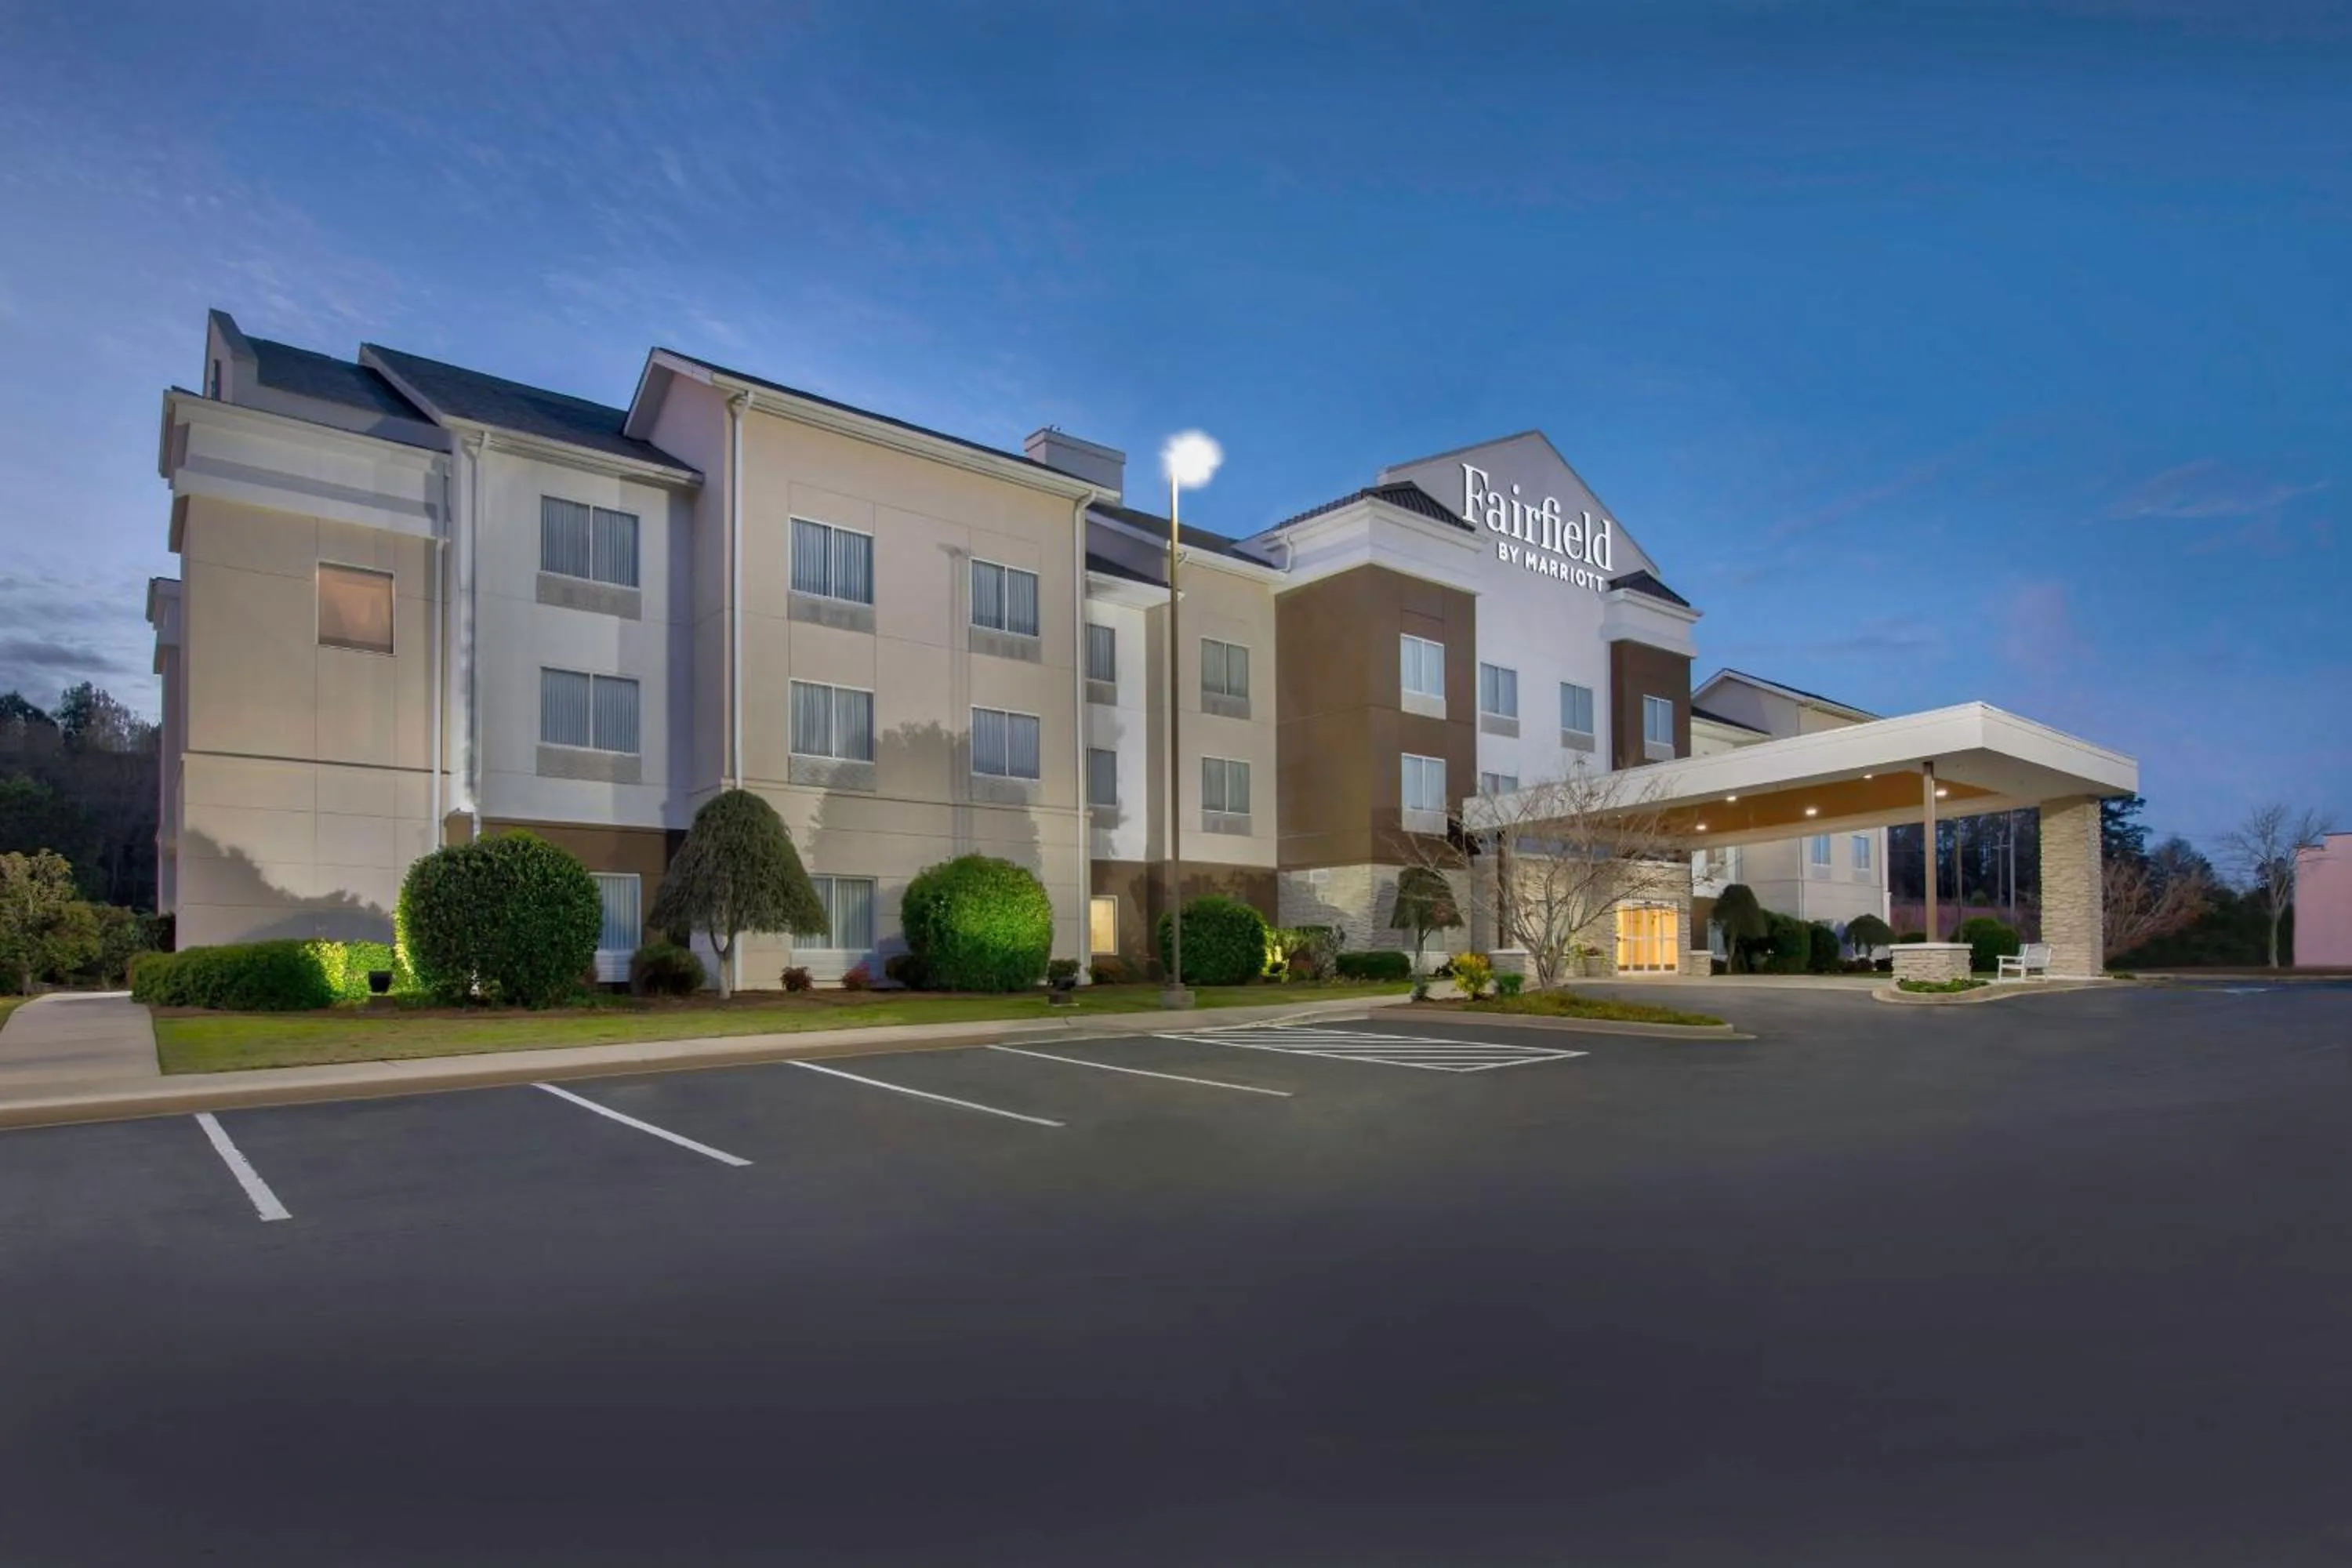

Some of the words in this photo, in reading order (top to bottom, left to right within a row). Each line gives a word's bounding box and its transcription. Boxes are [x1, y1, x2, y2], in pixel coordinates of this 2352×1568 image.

[1461, 463, 1613, 572] Fairfield
[1498, 543, 1519, 564] BY
[1526, 551, 1604, 592] MARRIOTT
